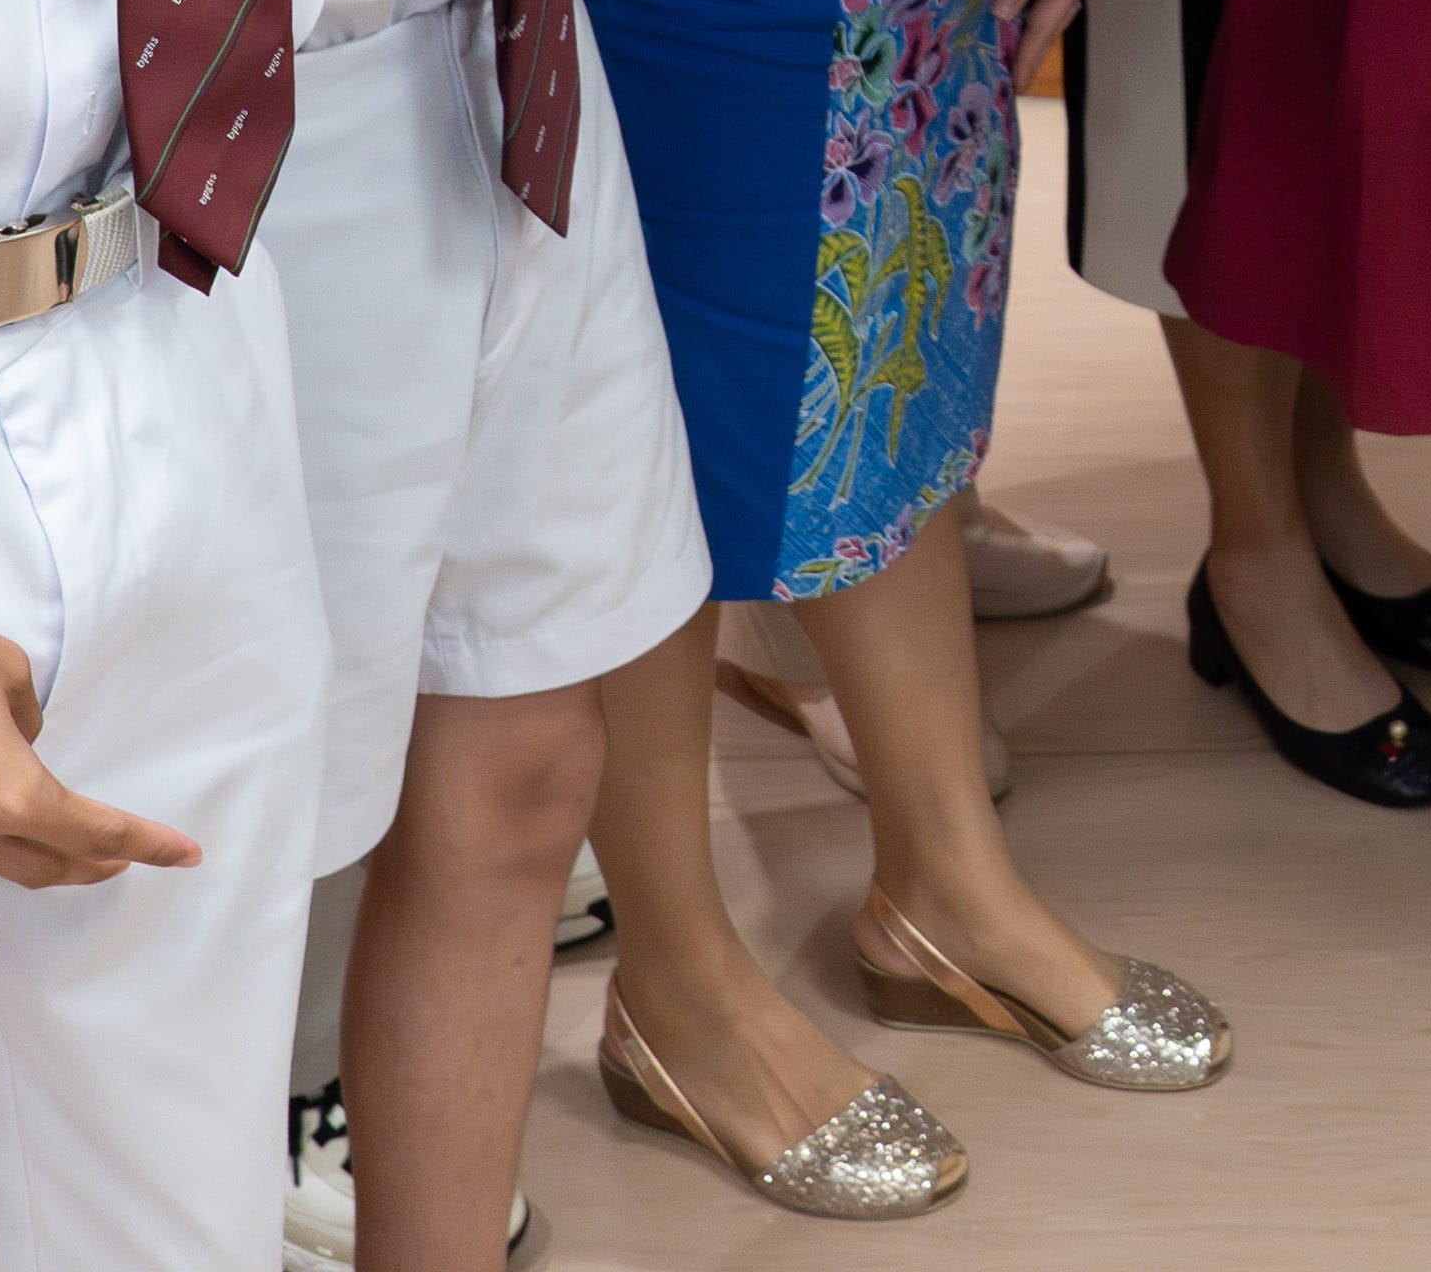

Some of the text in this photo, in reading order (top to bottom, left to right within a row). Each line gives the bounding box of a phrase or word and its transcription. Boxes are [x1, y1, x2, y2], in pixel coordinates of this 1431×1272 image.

[136, 37, 158, 68] bpghs
[227, 110, 248, 139] bpghs
[199, 174, 217, 205] bpghs
